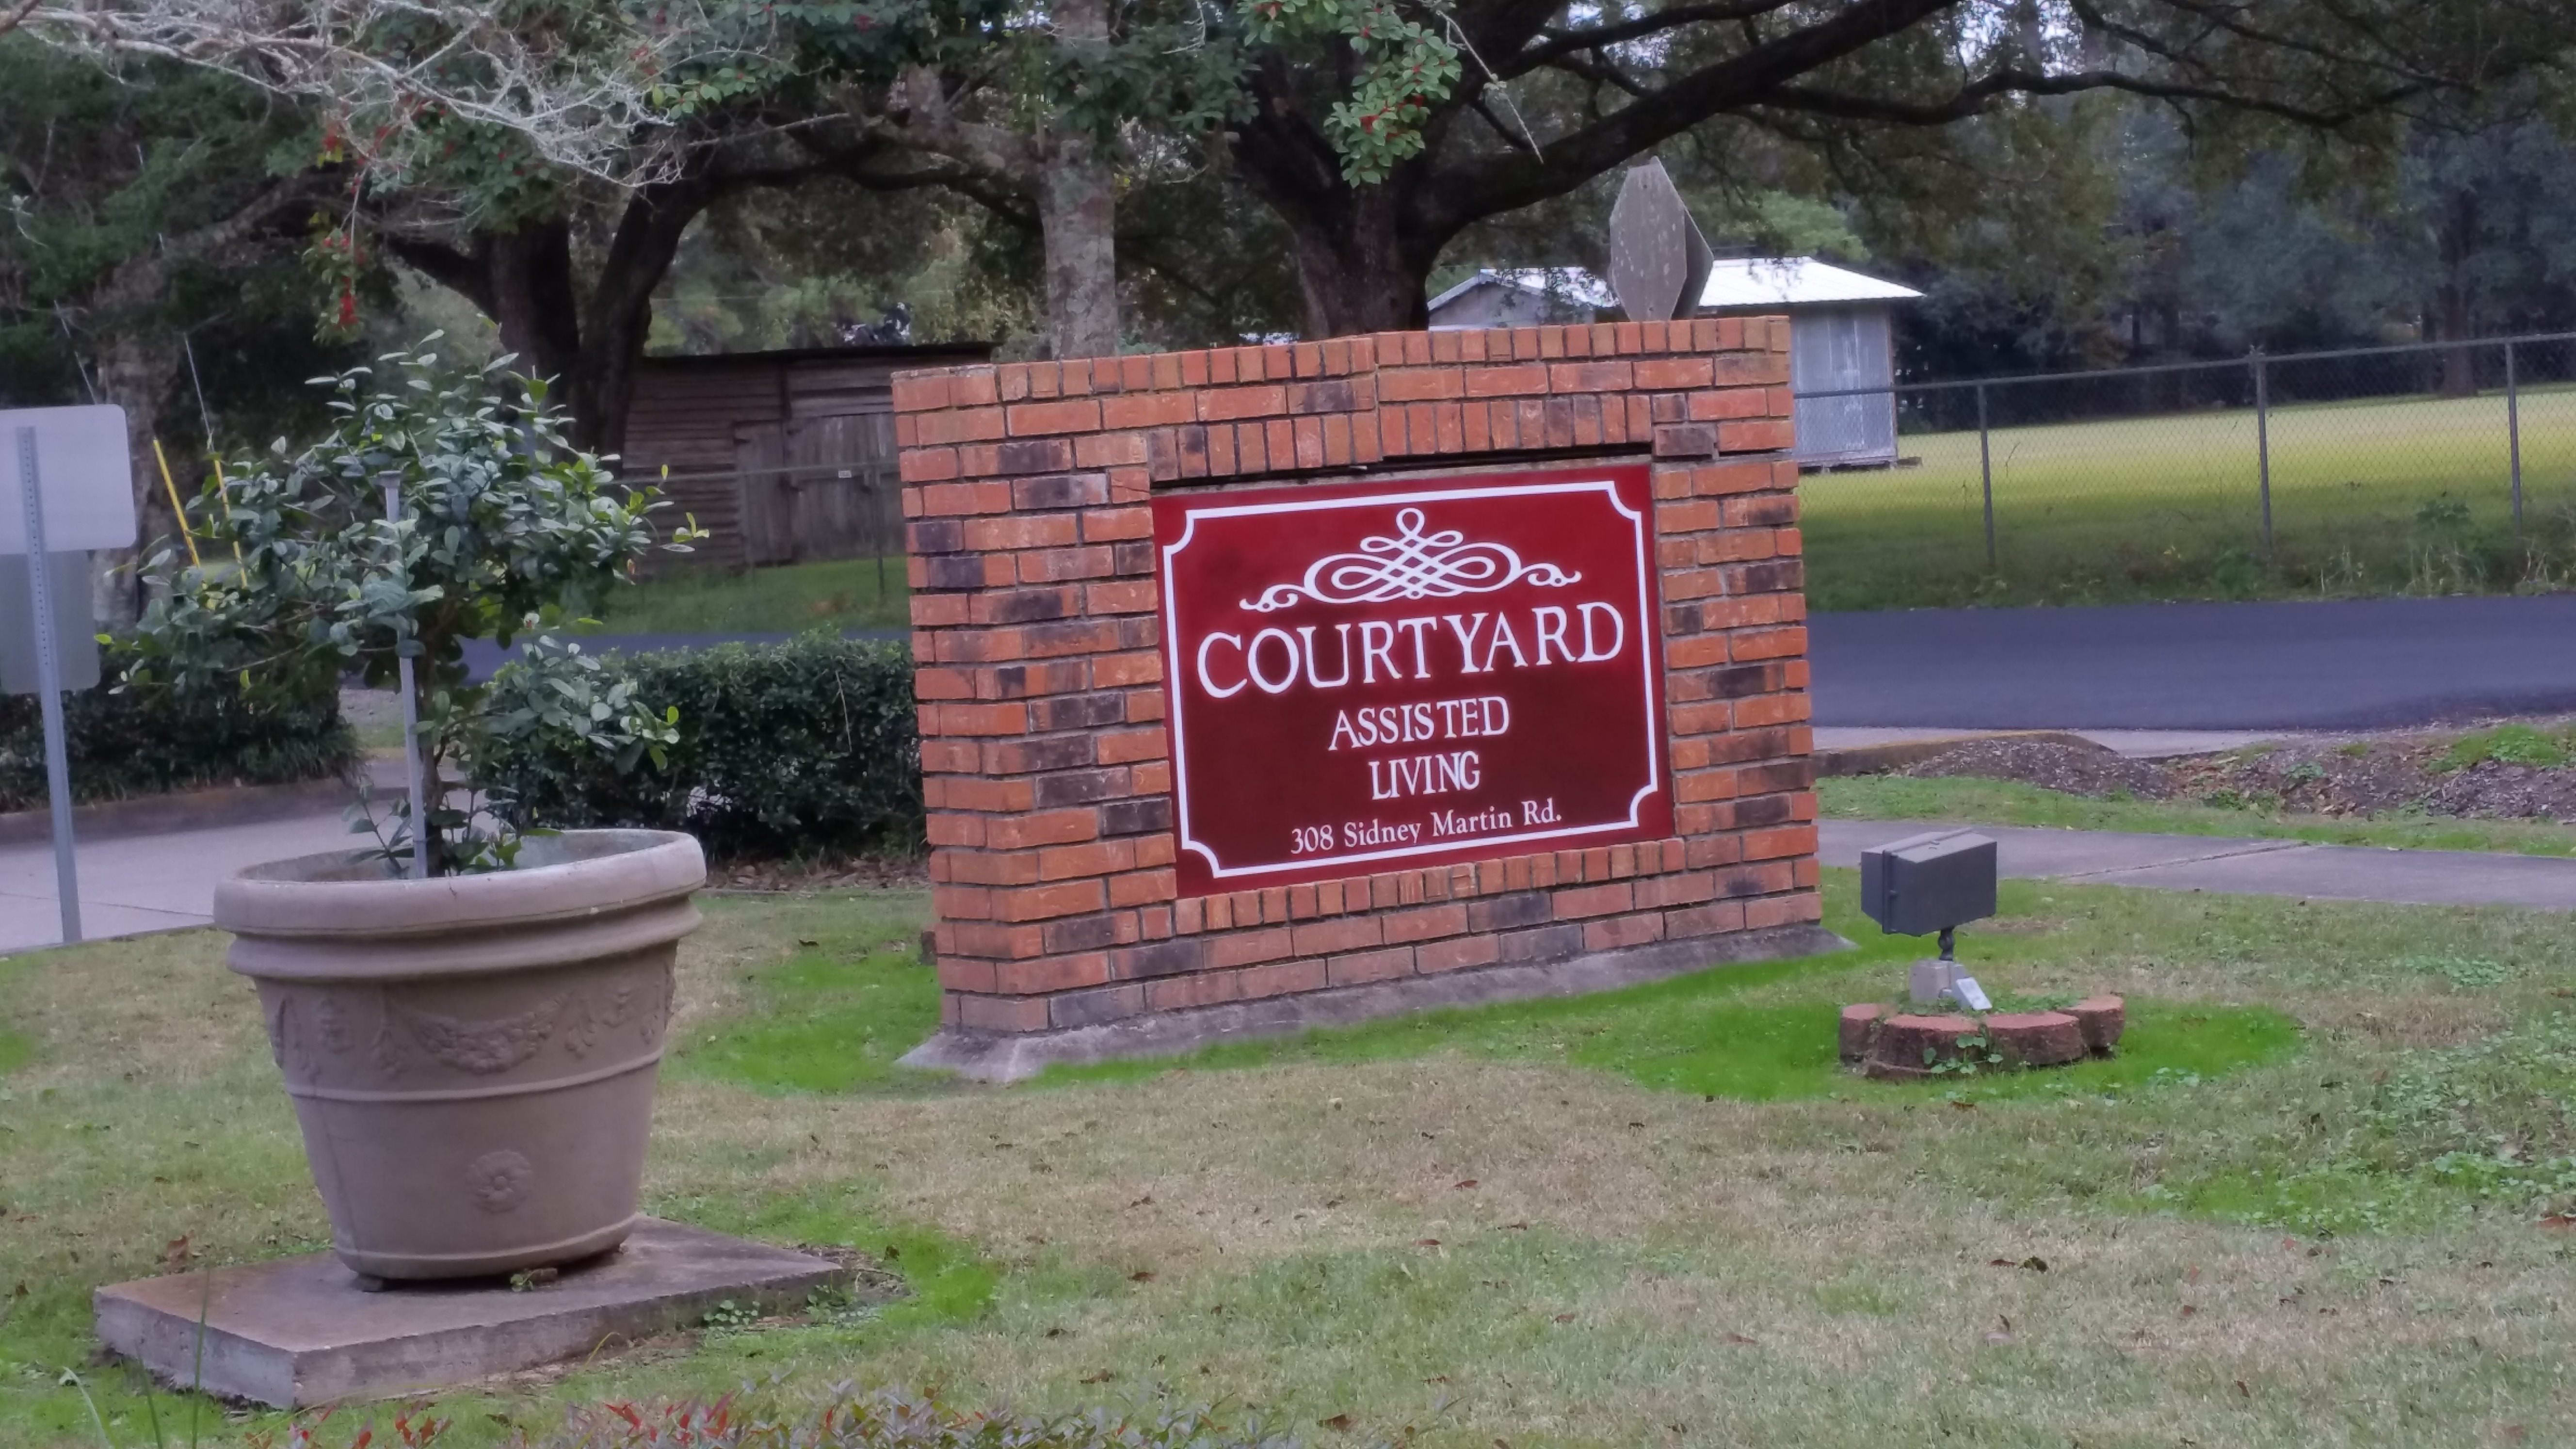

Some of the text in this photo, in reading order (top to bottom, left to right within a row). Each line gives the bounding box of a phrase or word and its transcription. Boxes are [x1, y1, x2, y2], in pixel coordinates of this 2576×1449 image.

[1196, 601, 1625, 699] COURTYARD
[1328, 696, 1510, 752] ASSISTED
[1368, 750, 1481, 801] LIVING
[1290, 797, 1562, 854] 308 Sidney Martin Rd.
